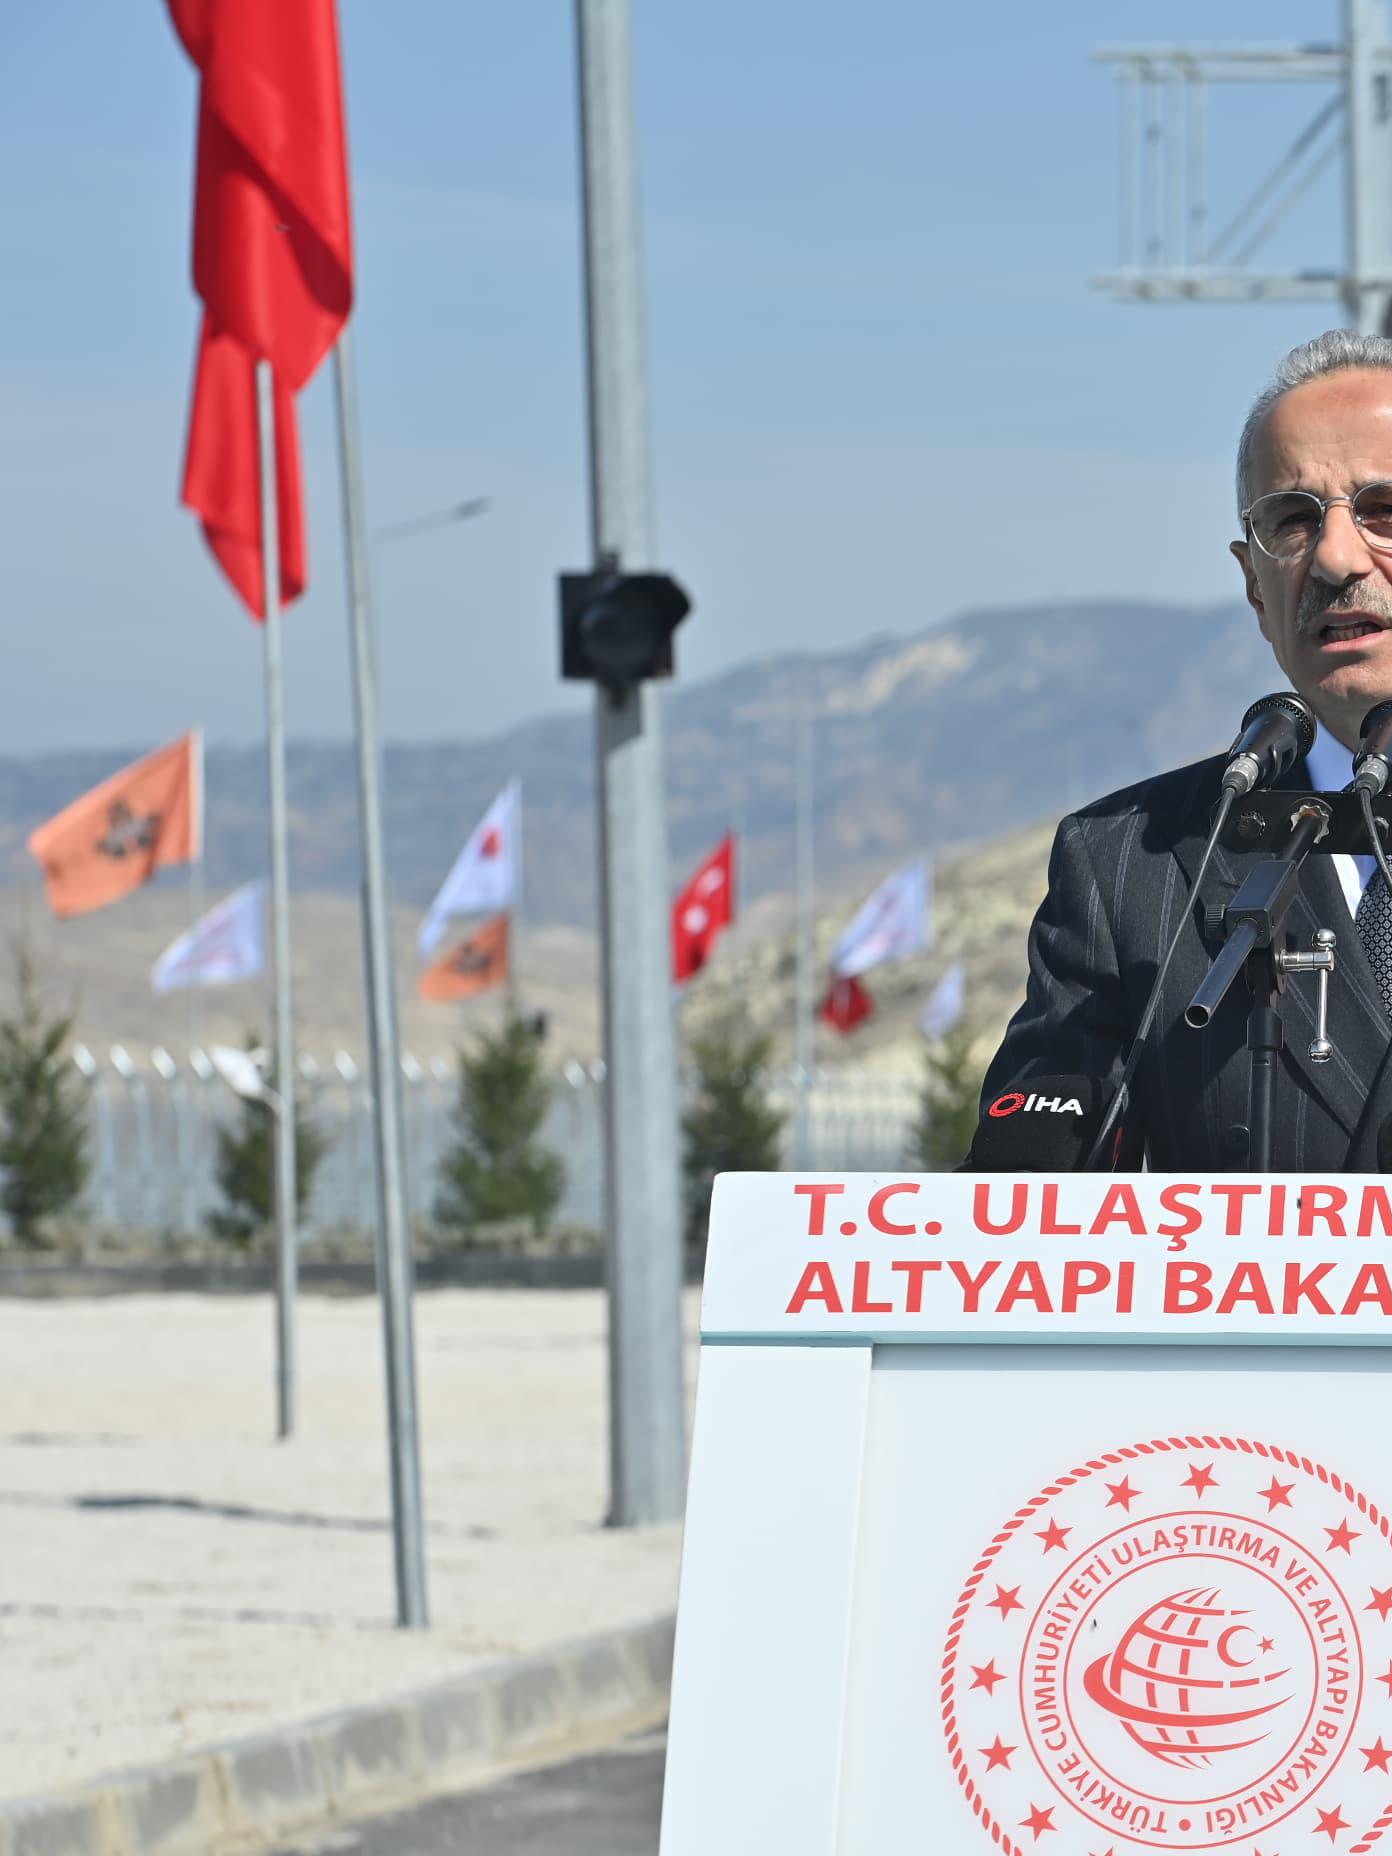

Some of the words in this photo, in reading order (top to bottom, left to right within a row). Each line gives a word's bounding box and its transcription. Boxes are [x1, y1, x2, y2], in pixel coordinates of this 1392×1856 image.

[795, 1183, 943, 1237] T.C.
[786, 1260, 1136, 1314] ALTYAPI
[1111, 1523, 1281, 1569] ULAŞTIRMA
[1283, 1556, 1320, 1597] VE
[1033, 1552, 1113, 1752] CUMHURİYETİ
[1308, 1598, 1351, 1716] ALTYAPI
[1057, 1751, 1169, 1835] TÜRKİYE
[1205, 1719, 1340, 1837] BAKANLIĞI
